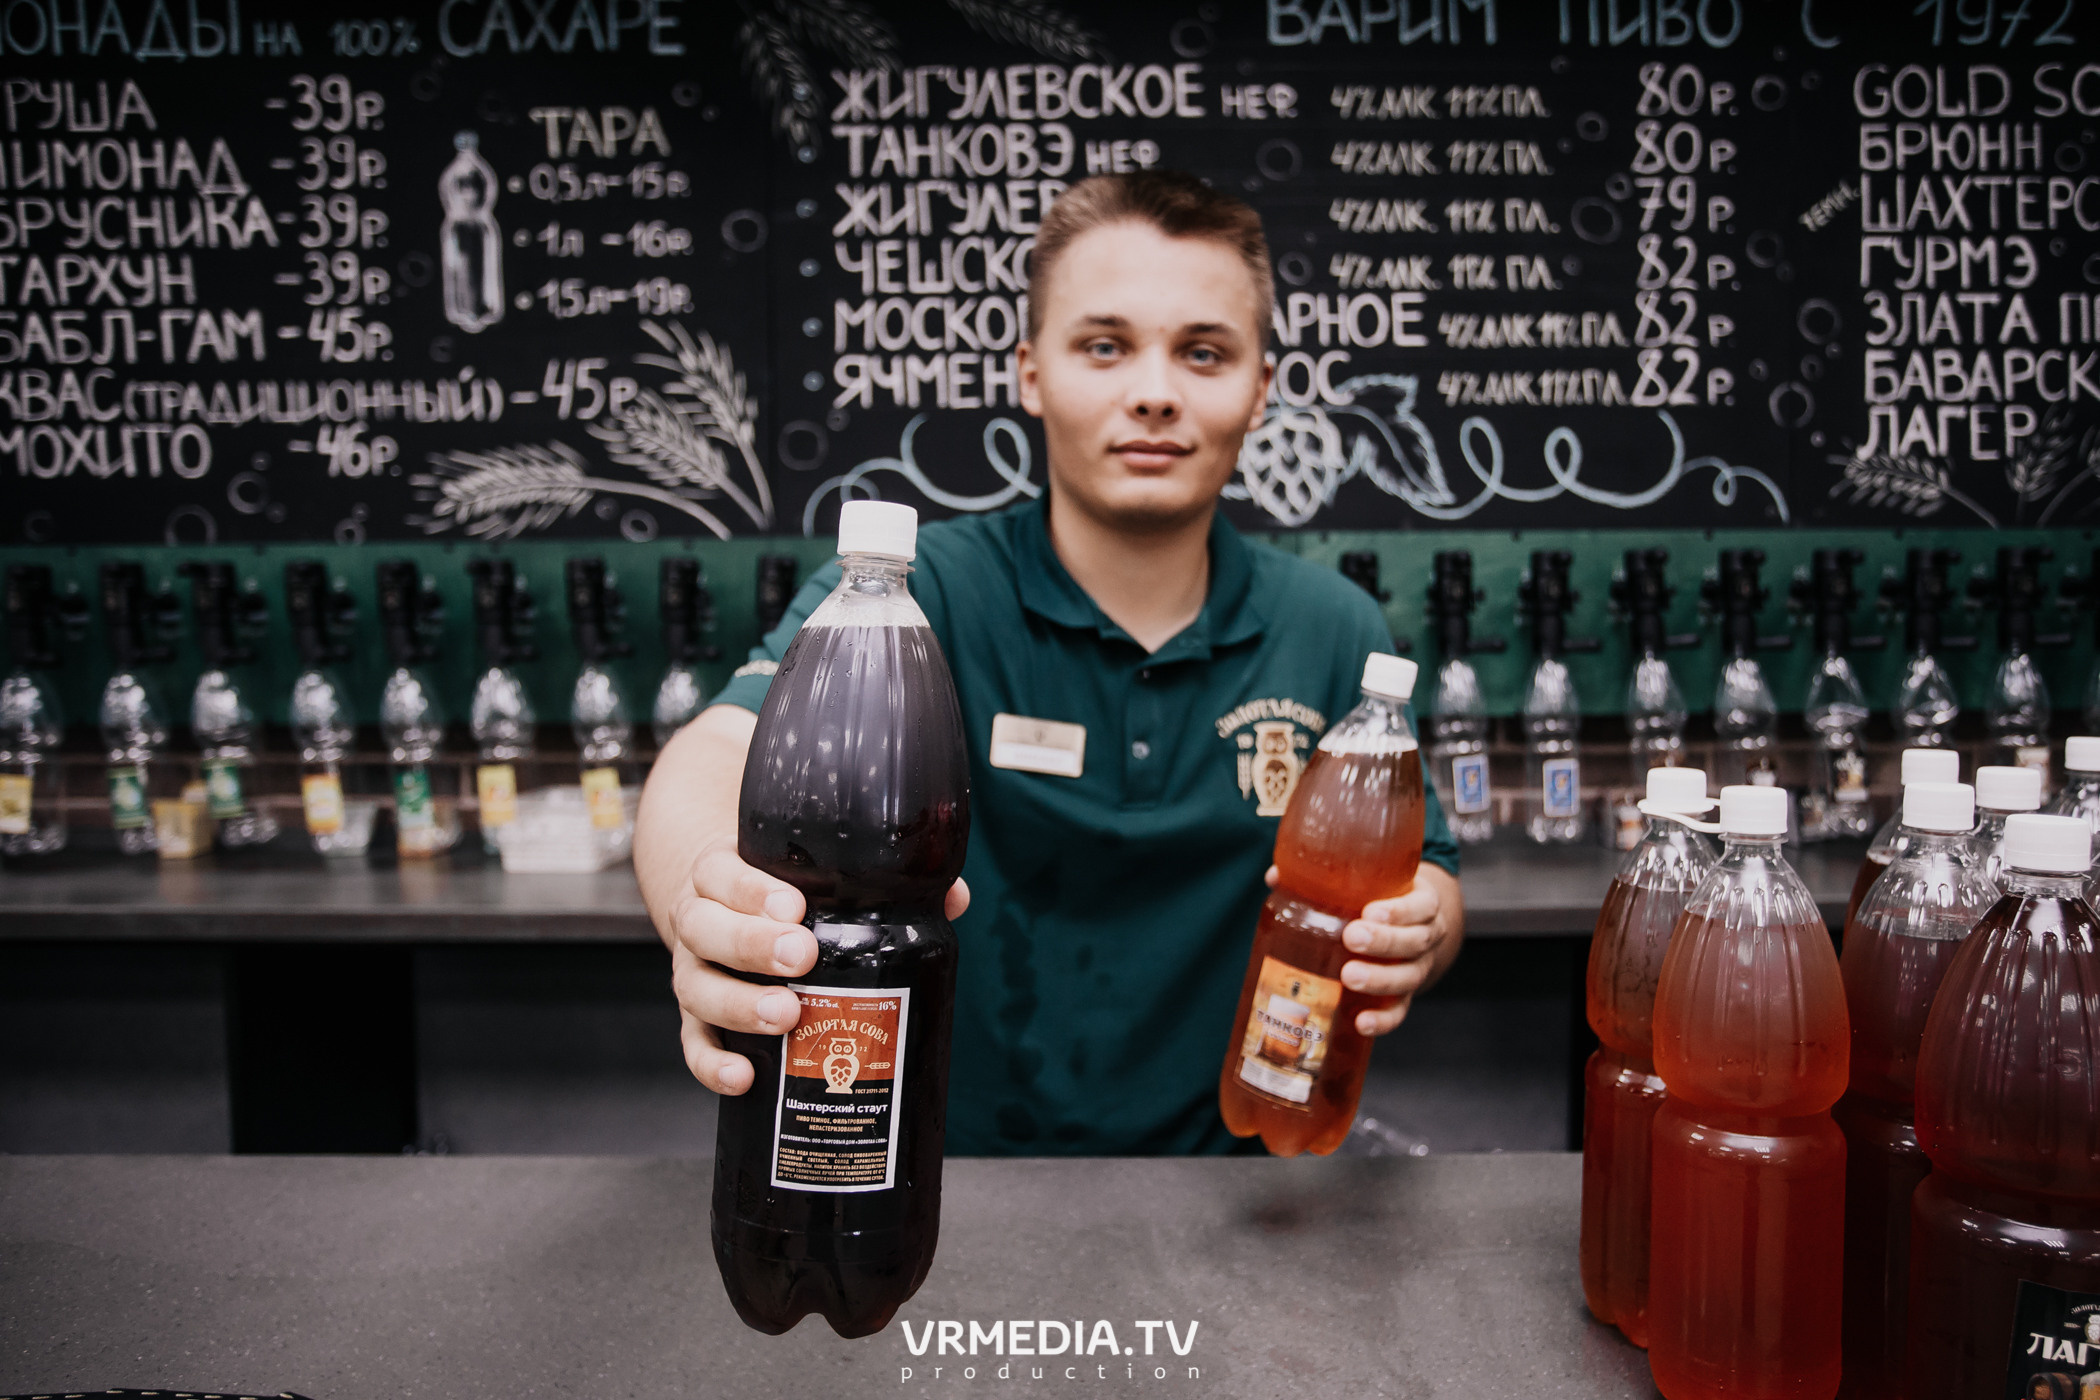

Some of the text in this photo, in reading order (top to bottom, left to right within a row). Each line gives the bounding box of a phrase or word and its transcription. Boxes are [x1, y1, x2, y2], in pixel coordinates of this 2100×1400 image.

[0, 0, 240, 62] ОНАДЫ
[328, 17, 421, 57] 100%
[438, 0, 688, 57] САХАРЕ
[1266, 0, 1499, 46] ВАРИМ
[1558, 0, 1743, 48] ПИВО
[1913, 0, 2078, 48] 1972
[830, 63, 1207, 121] ЖИГУЛЕВСКОЕ
[1853, 63, 2011, 118] GOLD
[527, 105, 673, 160] ТАРА
[831, 122, 1075, 178] ТАНКОВЭ
[1860, 123, 2043, 172] БРЮНН
[0, 138, 250, 199] ИМОНАД
[1860, 235, 2038, 290] ГУРМЭ
[834, 295, 1030, 353] МОСКО
[1864, 291, 2039, 346] ЗЛАТА
[1857, 404, 2036, 461] ЛАГЕР
[795, 1019, 889, 1046] ЗОЛОТАЯ СОВА
[786, 1098, 888, 1114] Шахтерский стаут
